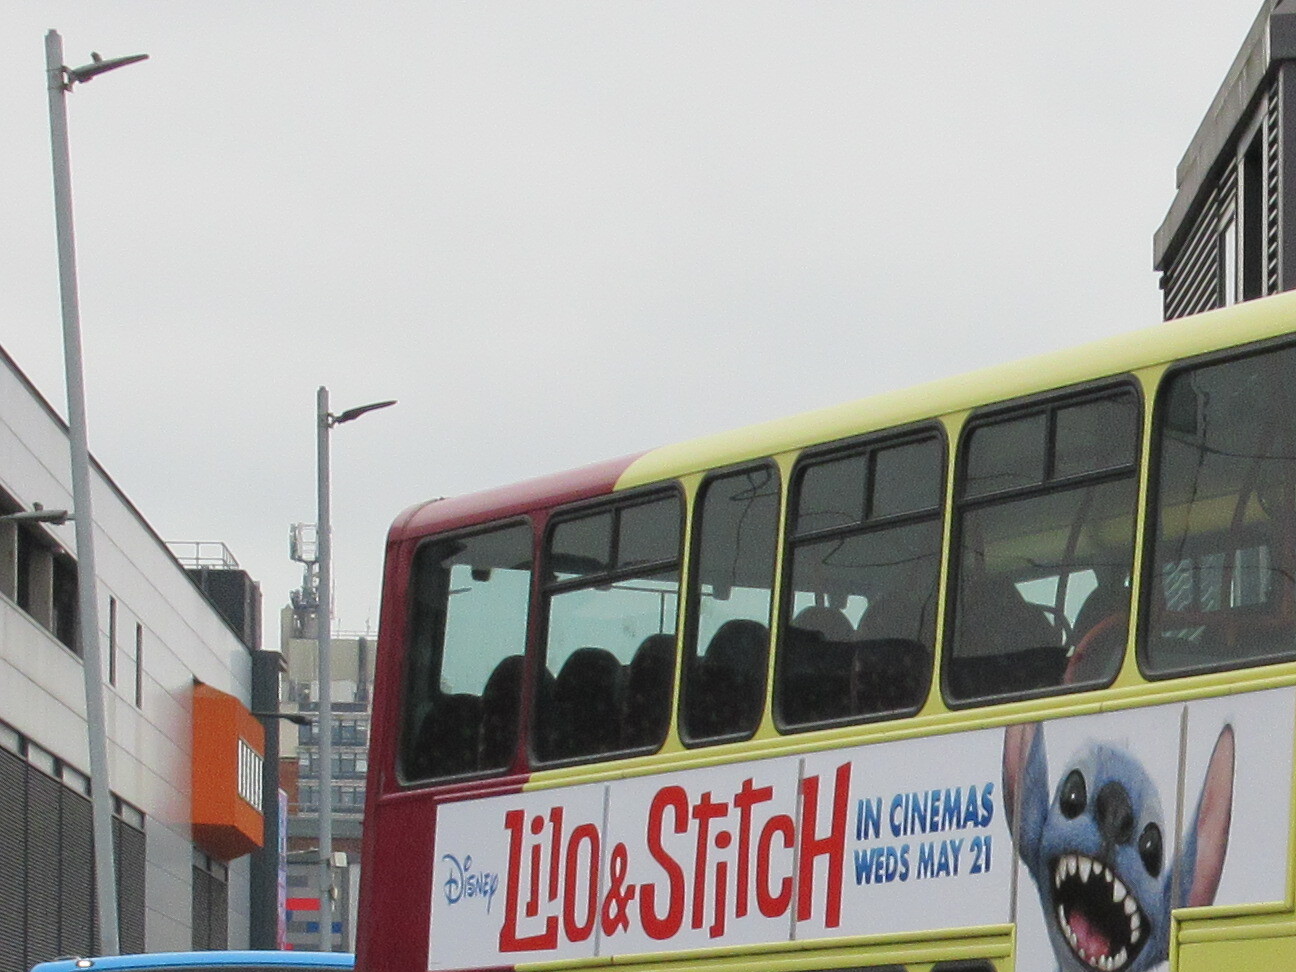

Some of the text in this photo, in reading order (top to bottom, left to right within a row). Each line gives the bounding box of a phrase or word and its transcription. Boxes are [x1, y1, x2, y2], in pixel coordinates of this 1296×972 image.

[856, 782, 995, 841] IN CINEMAS
[602, 841, 636, 938] &
[854, 835, 992, 885] WEDS MAY 21
